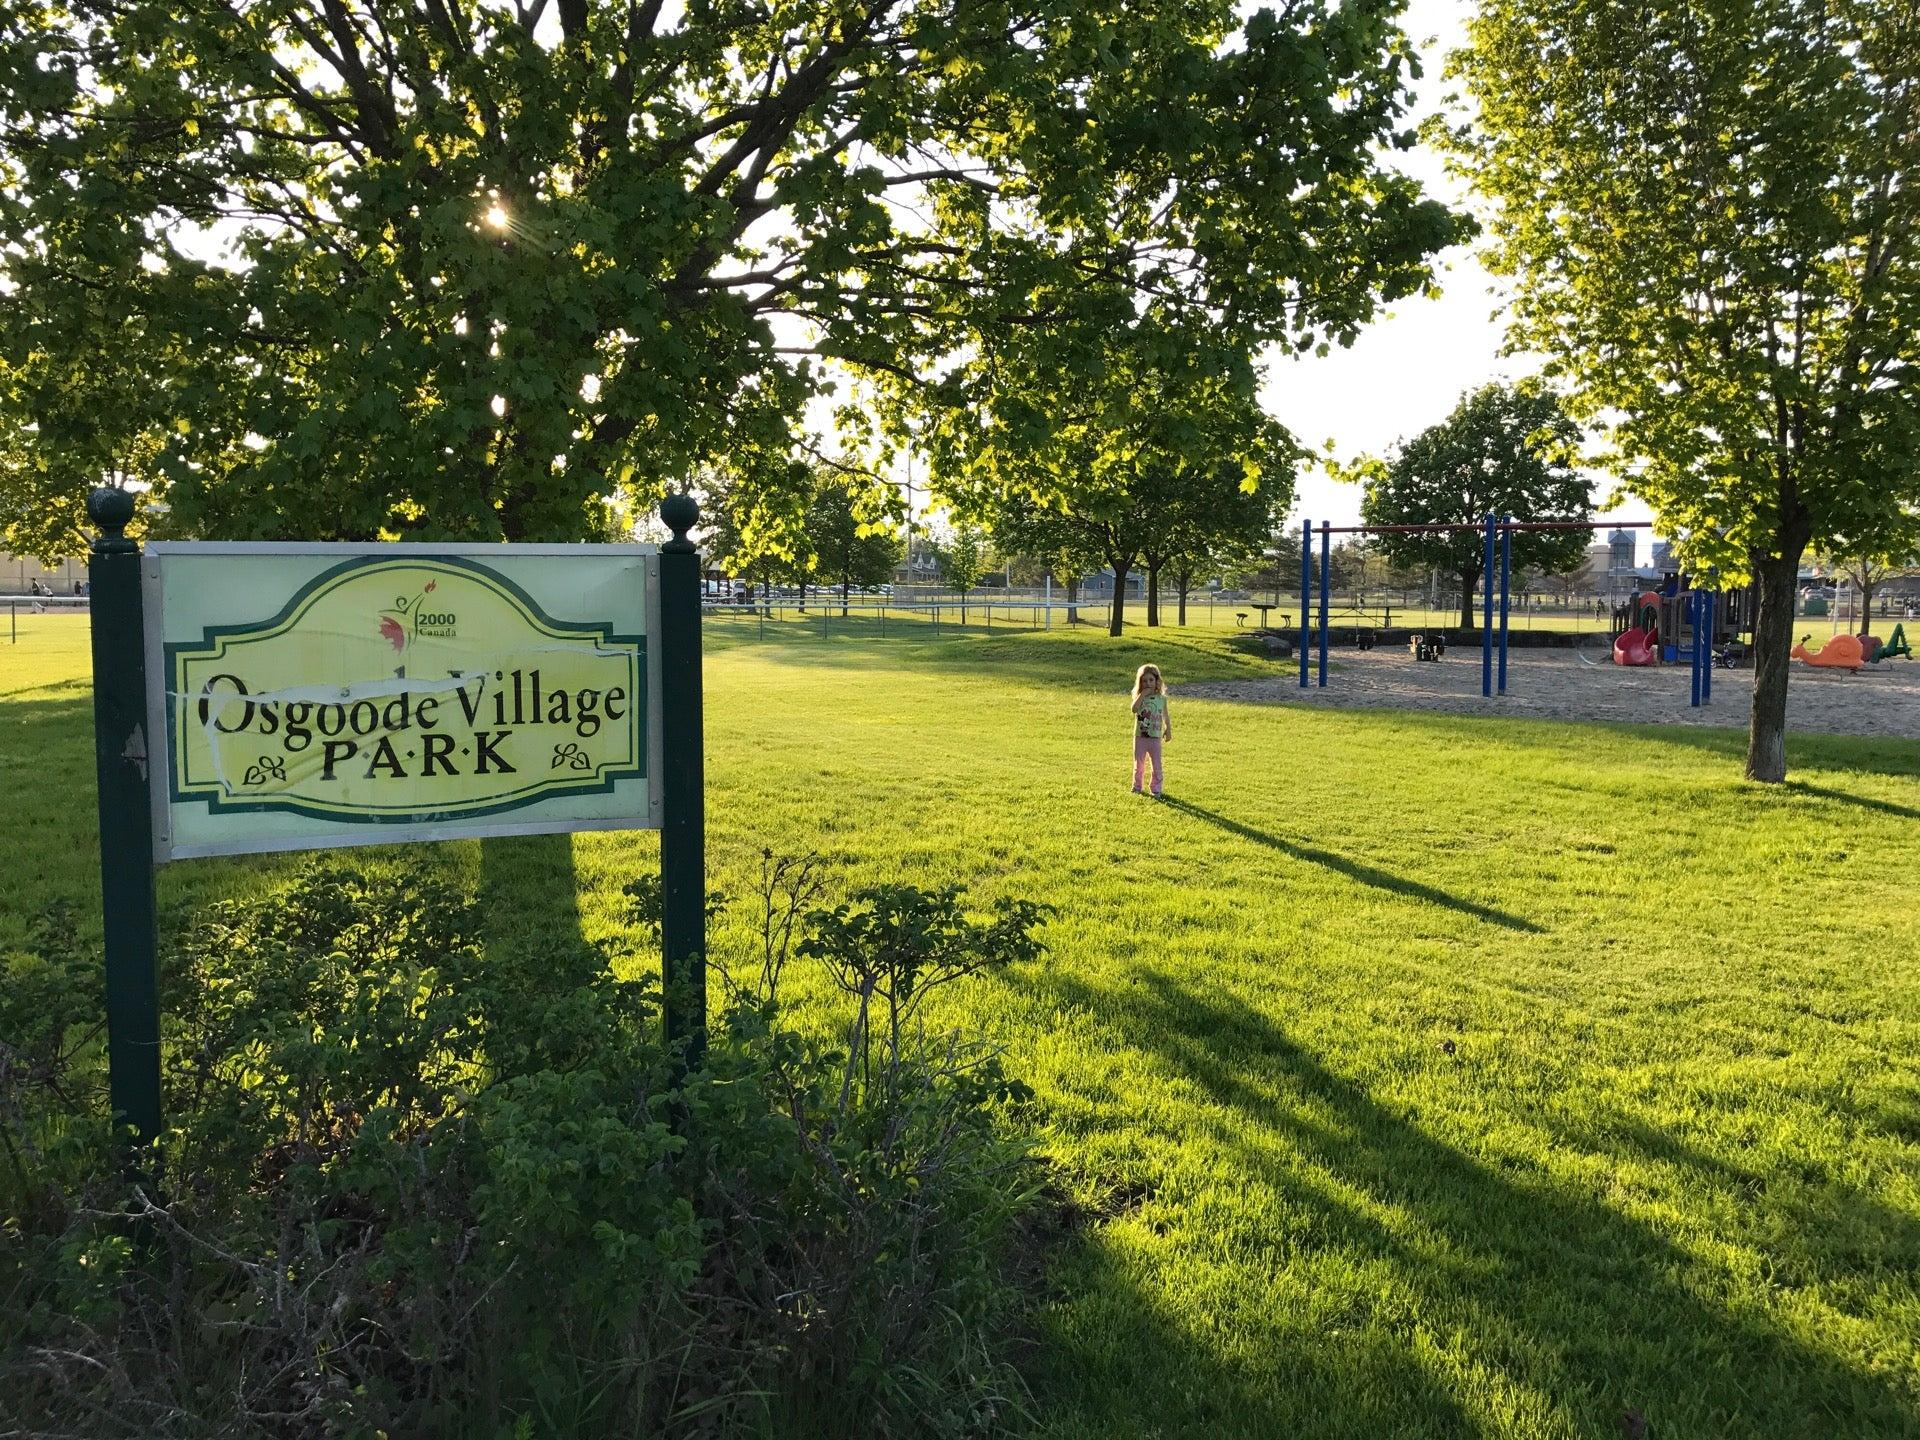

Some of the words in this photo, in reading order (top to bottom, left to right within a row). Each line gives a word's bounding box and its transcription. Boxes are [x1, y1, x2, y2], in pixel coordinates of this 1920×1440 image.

[418, 613, 456, 625] 2000
[419, 628, 457, 638] Canada
[198, 665, 439, 752] Osgoode
[447, 669, 626, 738] Village
